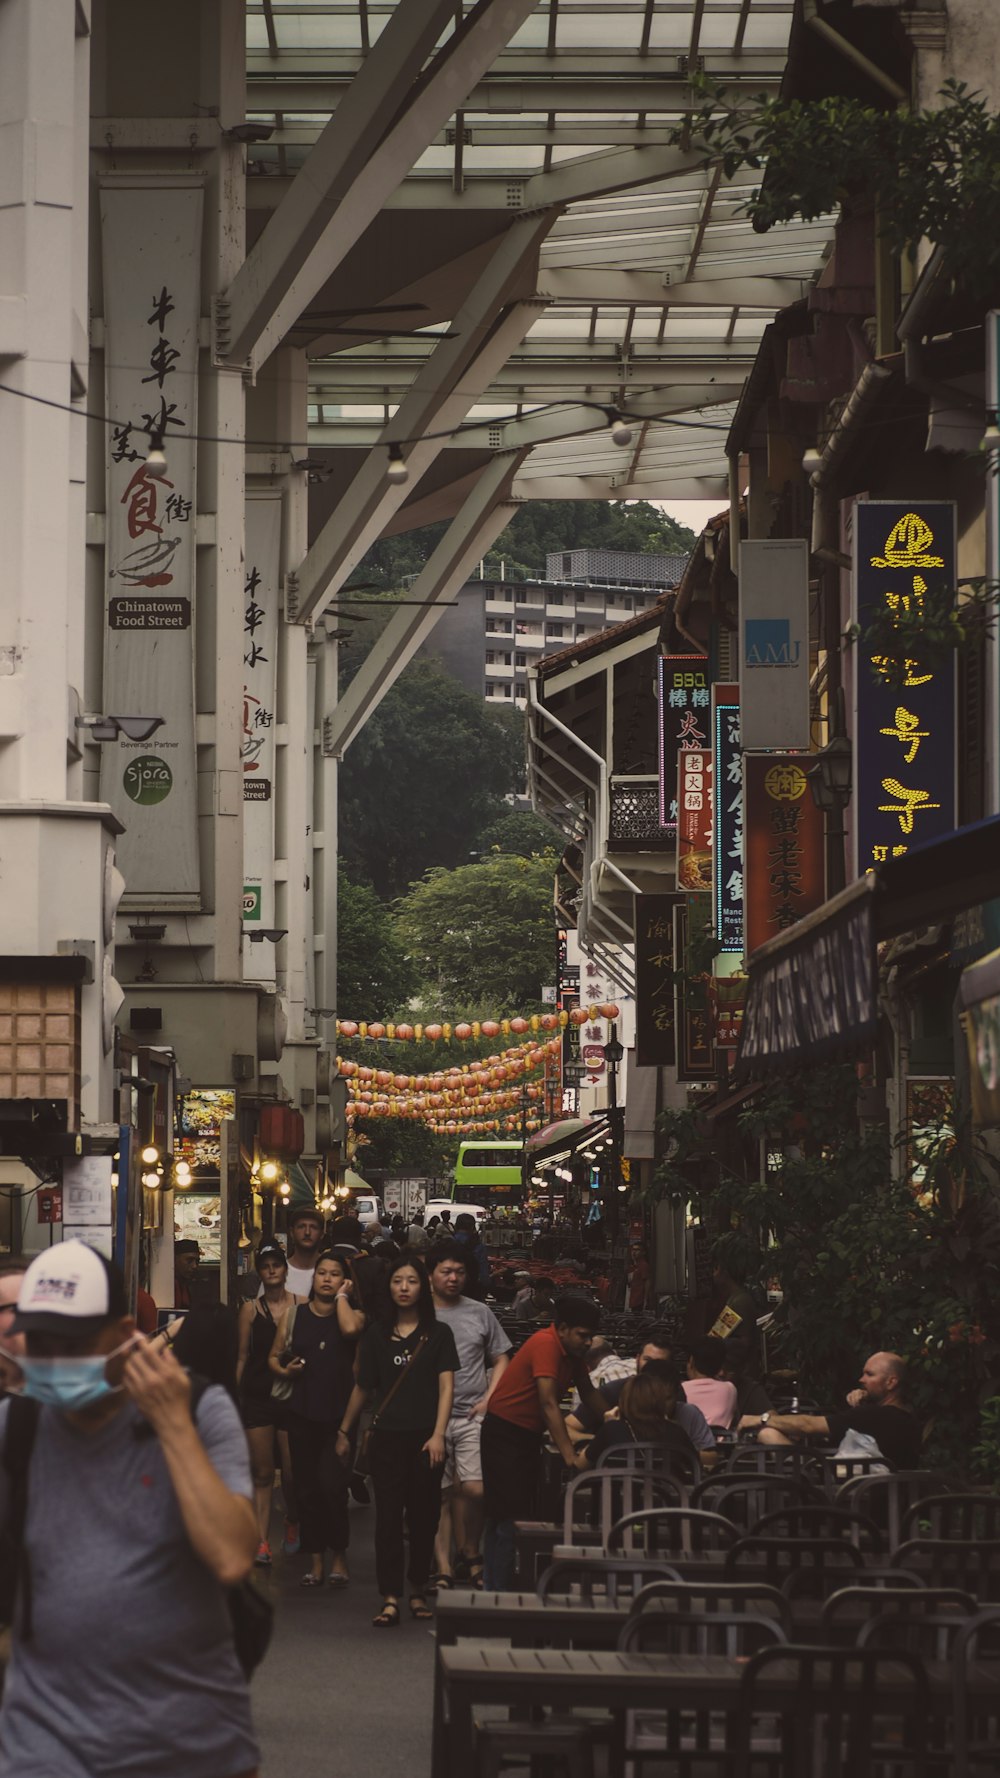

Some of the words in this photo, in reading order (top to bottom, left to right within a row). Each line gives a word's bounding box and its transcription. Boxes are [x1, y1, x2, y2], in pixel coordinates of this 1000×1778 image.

[116, 600, 183, 613] Chinatown
[116, 614, 145, 628] Food
[147, 614, 184, 628] Street
[745, 641, 801, 664] AMJ
[673, 672, 706, 688] BBQ
[668, 688, 711, 708] 棒棒
[120, 741, 153, 750] Beverage
[154, 741, 179, 749] Partner
[686, 755, 702, 809] 老火锅
[585, 961, 604, 1042] 飲茶樓
